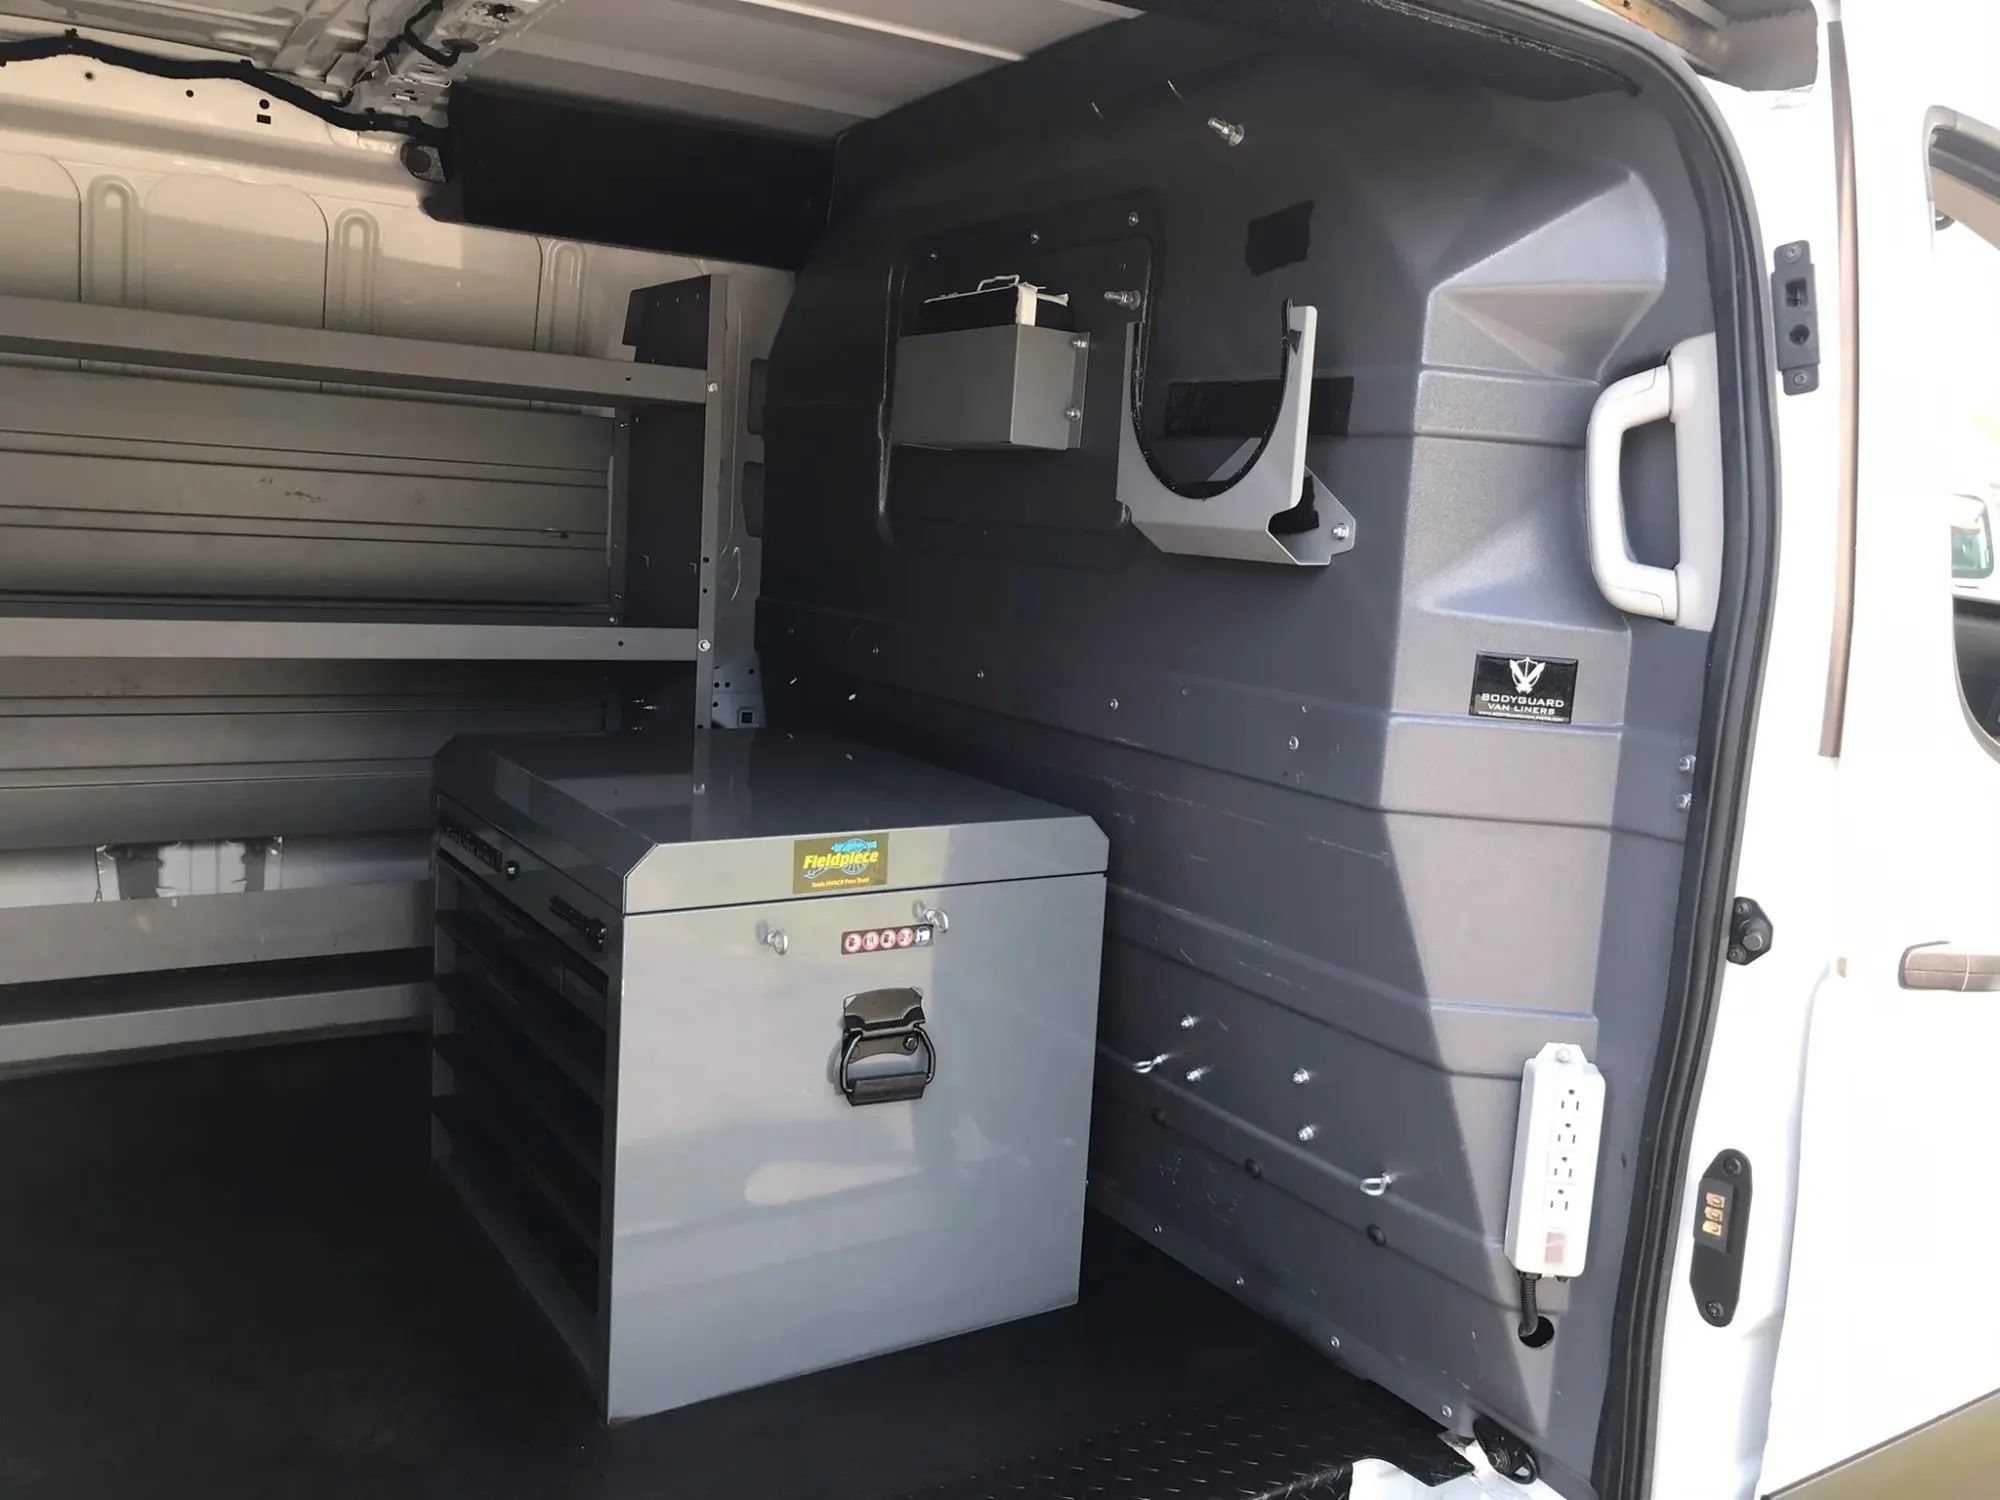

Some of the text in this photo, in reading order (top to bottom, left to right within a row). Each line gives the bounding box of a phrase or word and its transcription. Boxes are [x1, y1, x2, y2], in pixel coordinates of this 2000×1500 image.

[1482, 693, 1564, 708] BODYGUARD
[1488, 703, 1510, 711] VAN
[803, 851, 879, 870] Fieldpiece
